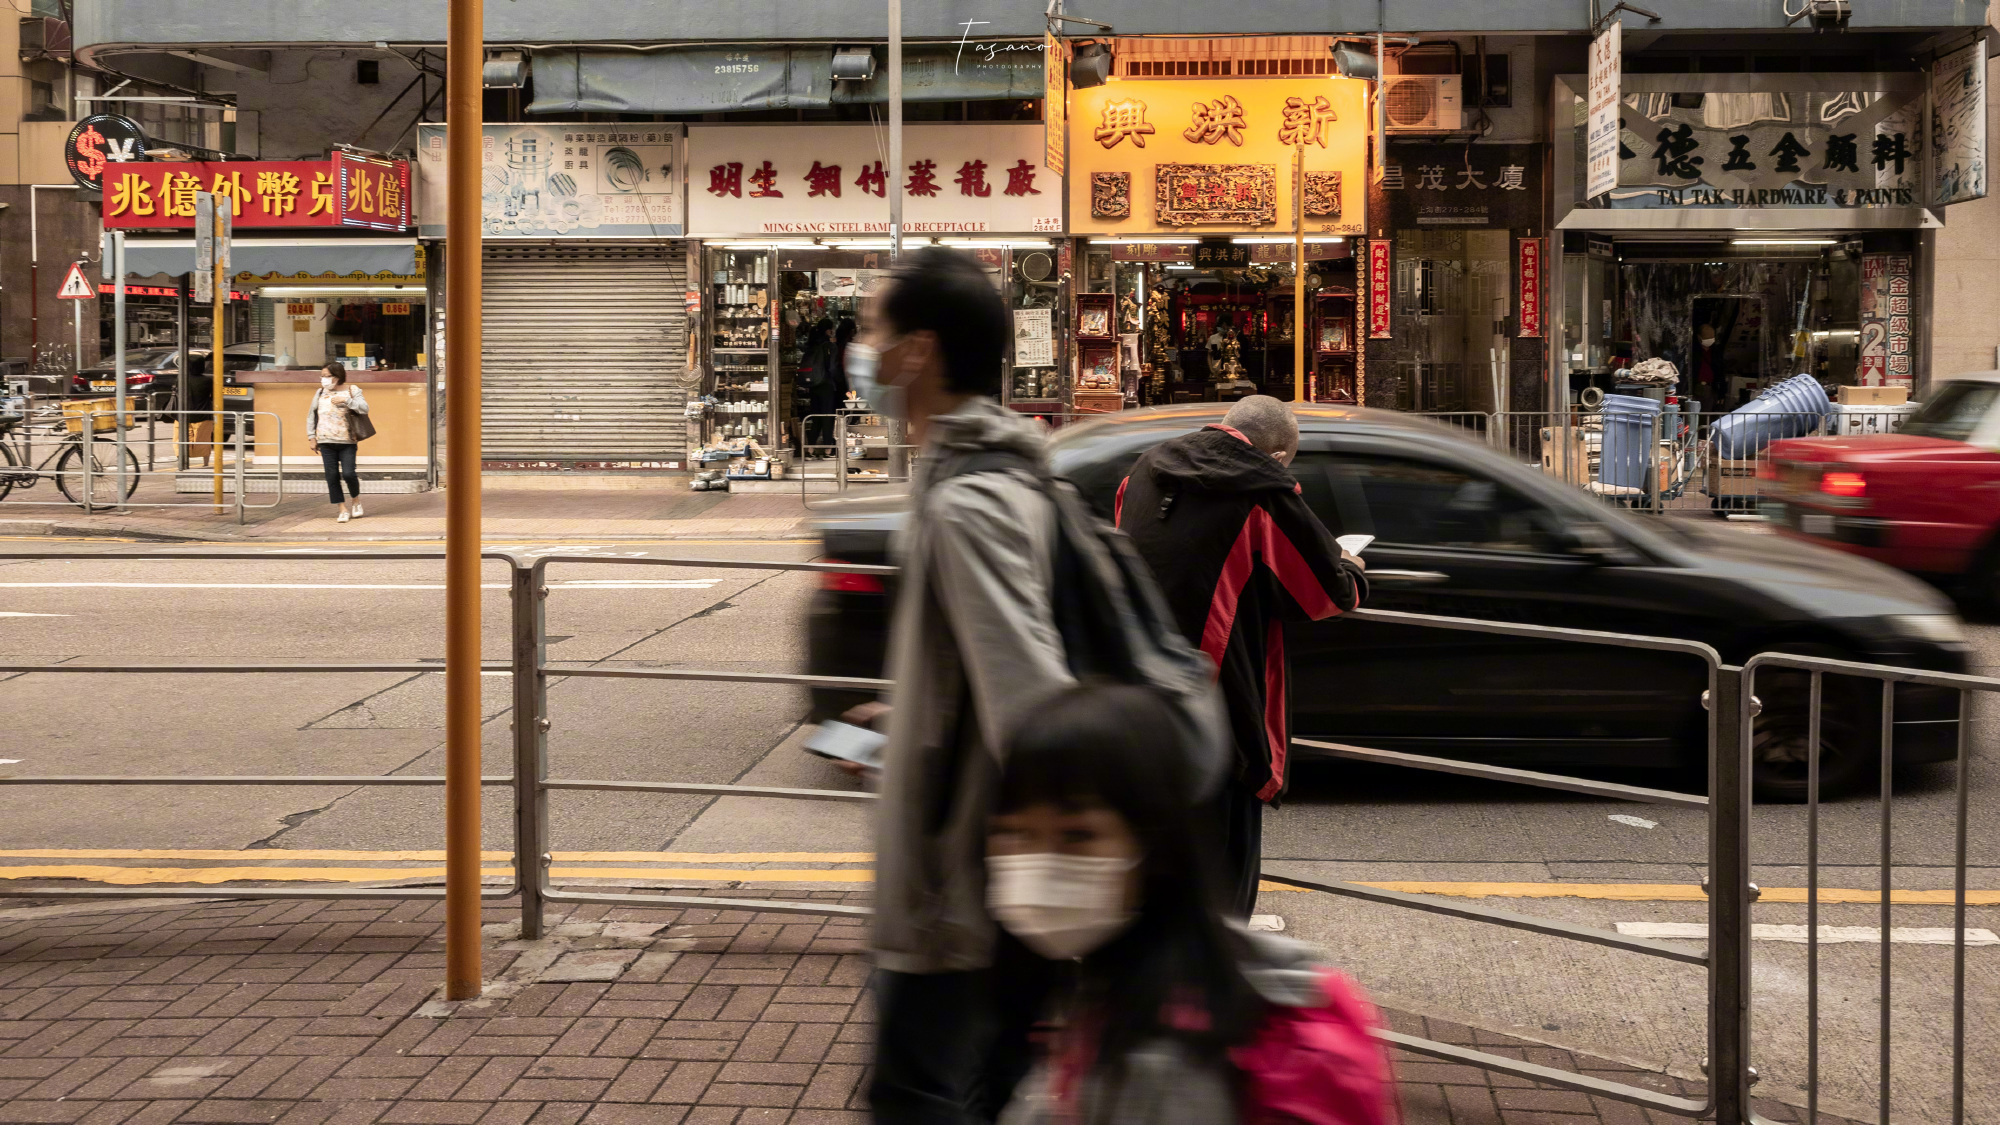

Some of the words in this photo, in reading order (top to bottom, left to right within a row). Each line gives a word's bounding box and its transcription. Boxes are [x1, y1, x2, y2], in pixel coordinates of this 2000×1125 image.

[714, 64, 759, 74] 23815756
[348, 168, 400, 218] 兆億
[1656, 190, 1683, 205] TAI
[1691, 190, 1725, 205] TAK
[1732, 189, 1828, 205] HARDWARE
[1834, 189, 1848, 205] &
[1855, 189, 1913, 205] PAINTS
[763, 223, 793, 232] MING
[796, 223, 825, 232] SANG
[829, 223, 861, 232] STEEL
[864, 222, 909, 232] BAMO
[914, 222, 986, 232] RECEPTACLE
[1321, 224, 1362, 232] 280-284G
[1865, 269, 1884, 278] TAK
[1889, 258, 1909, 374] 五金超級市場
